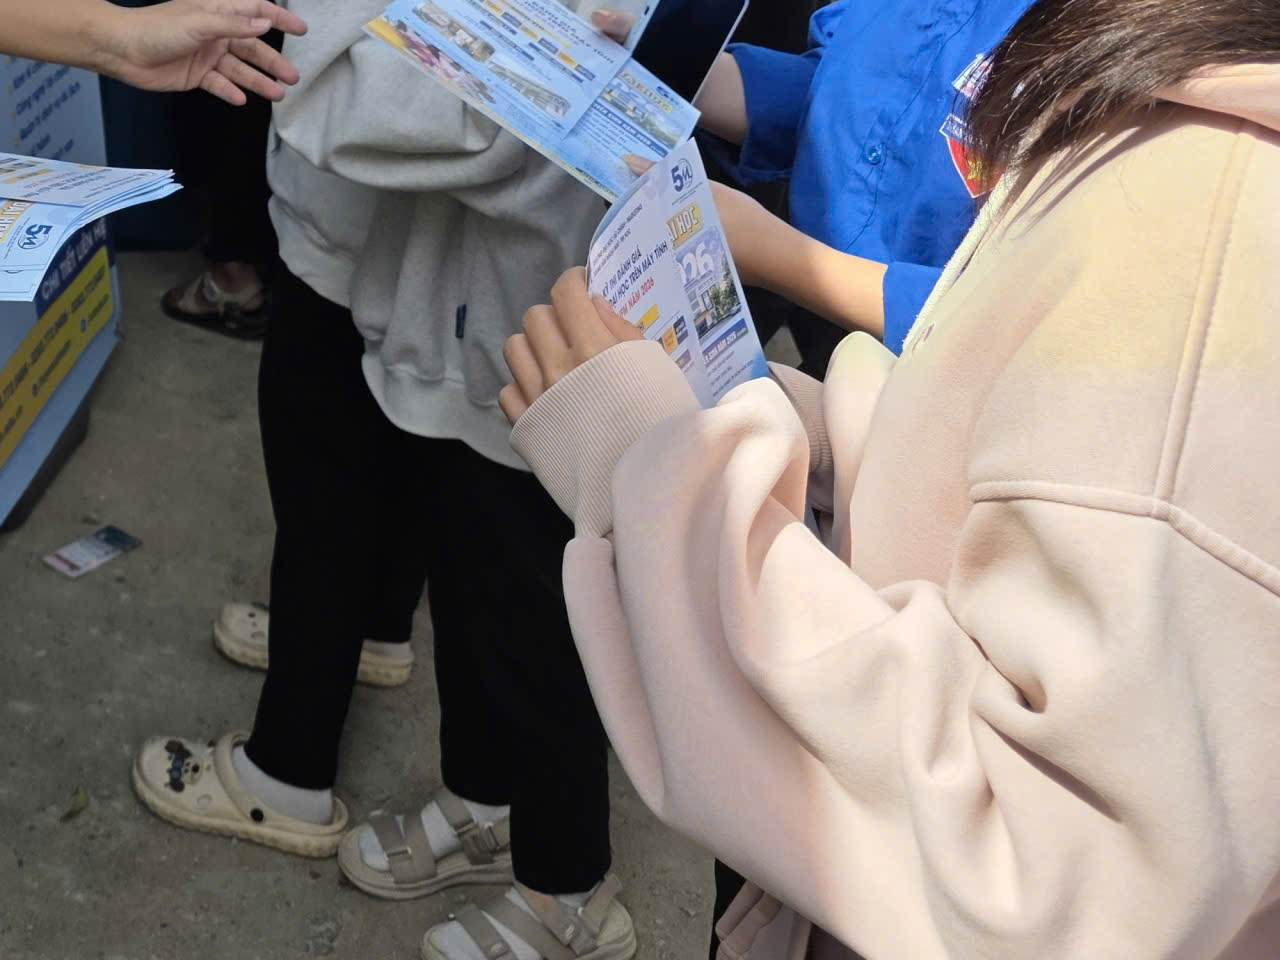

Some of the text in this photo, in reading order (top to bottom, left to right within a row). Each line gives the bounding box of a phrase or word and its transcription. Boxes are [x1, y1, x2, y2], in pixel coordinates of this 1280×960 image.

[626, 265, 643, 284] TRÊN
[639, 253, 654, 272] MÁY
[651, 239, 669, 259] TÍNH
[41, 271, 61, 300] CHI
